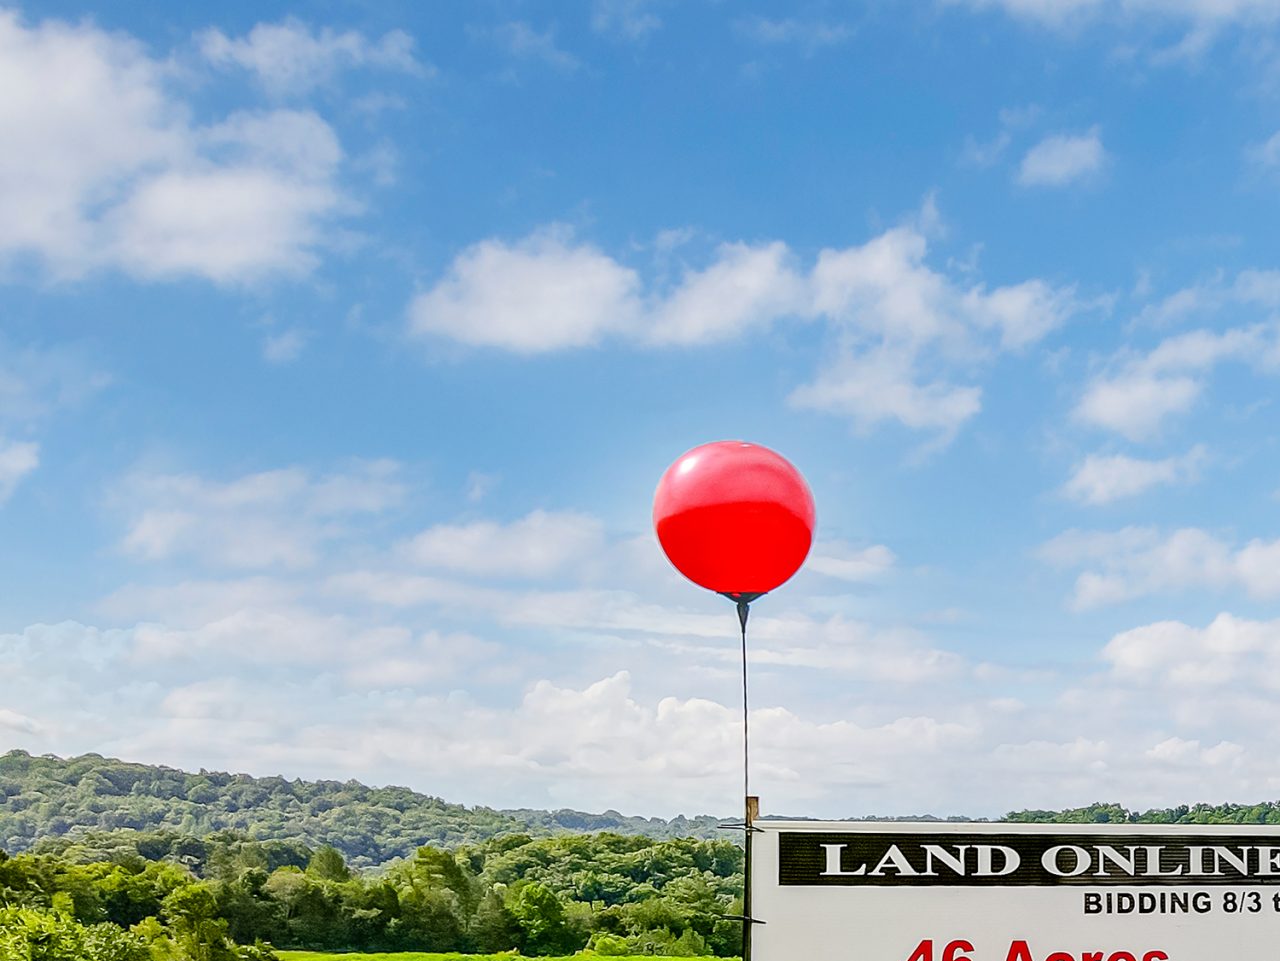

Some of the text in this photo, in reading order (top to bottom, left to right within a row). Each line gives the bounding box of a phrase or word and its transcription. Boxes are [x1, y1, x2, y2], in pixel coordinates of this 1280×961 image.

[819, 843, 1021, 877] LAND
[1083, 891, 1213, 915] BIDDING
[1222, 890, 1262, 914] 8/3
